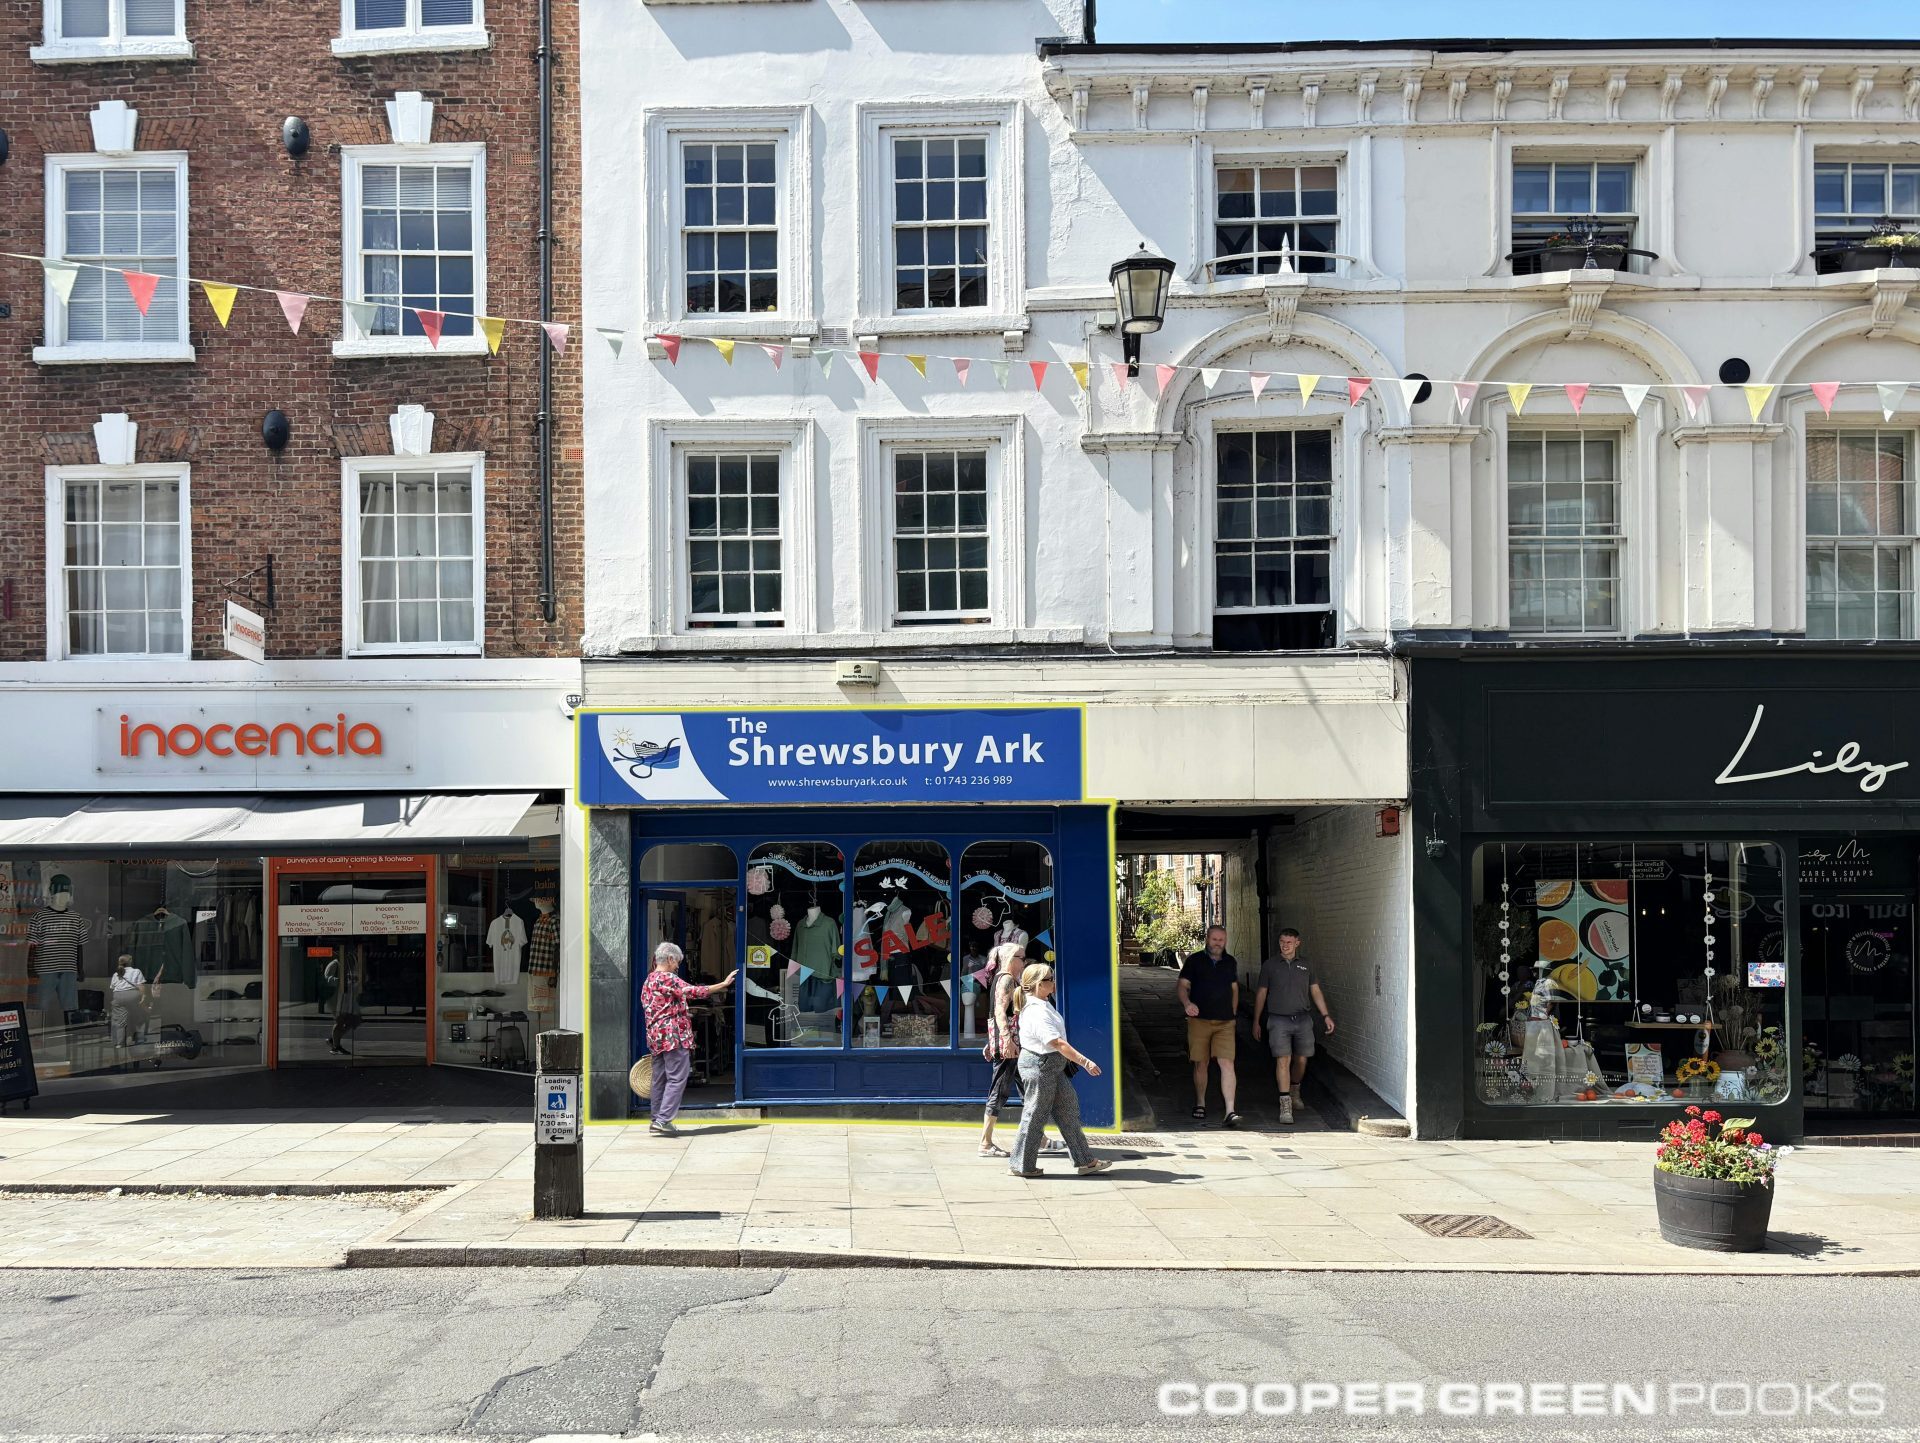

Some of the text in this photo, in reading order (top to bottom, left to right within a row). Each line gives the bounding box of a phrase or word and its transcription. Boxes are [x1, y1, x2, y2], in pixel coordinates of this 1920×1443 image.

[234, 620, 262, 641] inocencia
[120, 713, 382, 757] inocencia
[727, 717, 768, 734] The
[728, 734, 1045, 772] Shrewsbury Ark
[1714, 704, 1909, 792] Lily
[768, 775, 1013, 788] www.shrewsburyark.co.uk t: 01743 236 989
[1798, 849, 1831, 861] ily
[992, 872, 1006, 884] THEIR
[854, 911, 951, 968] SALE
